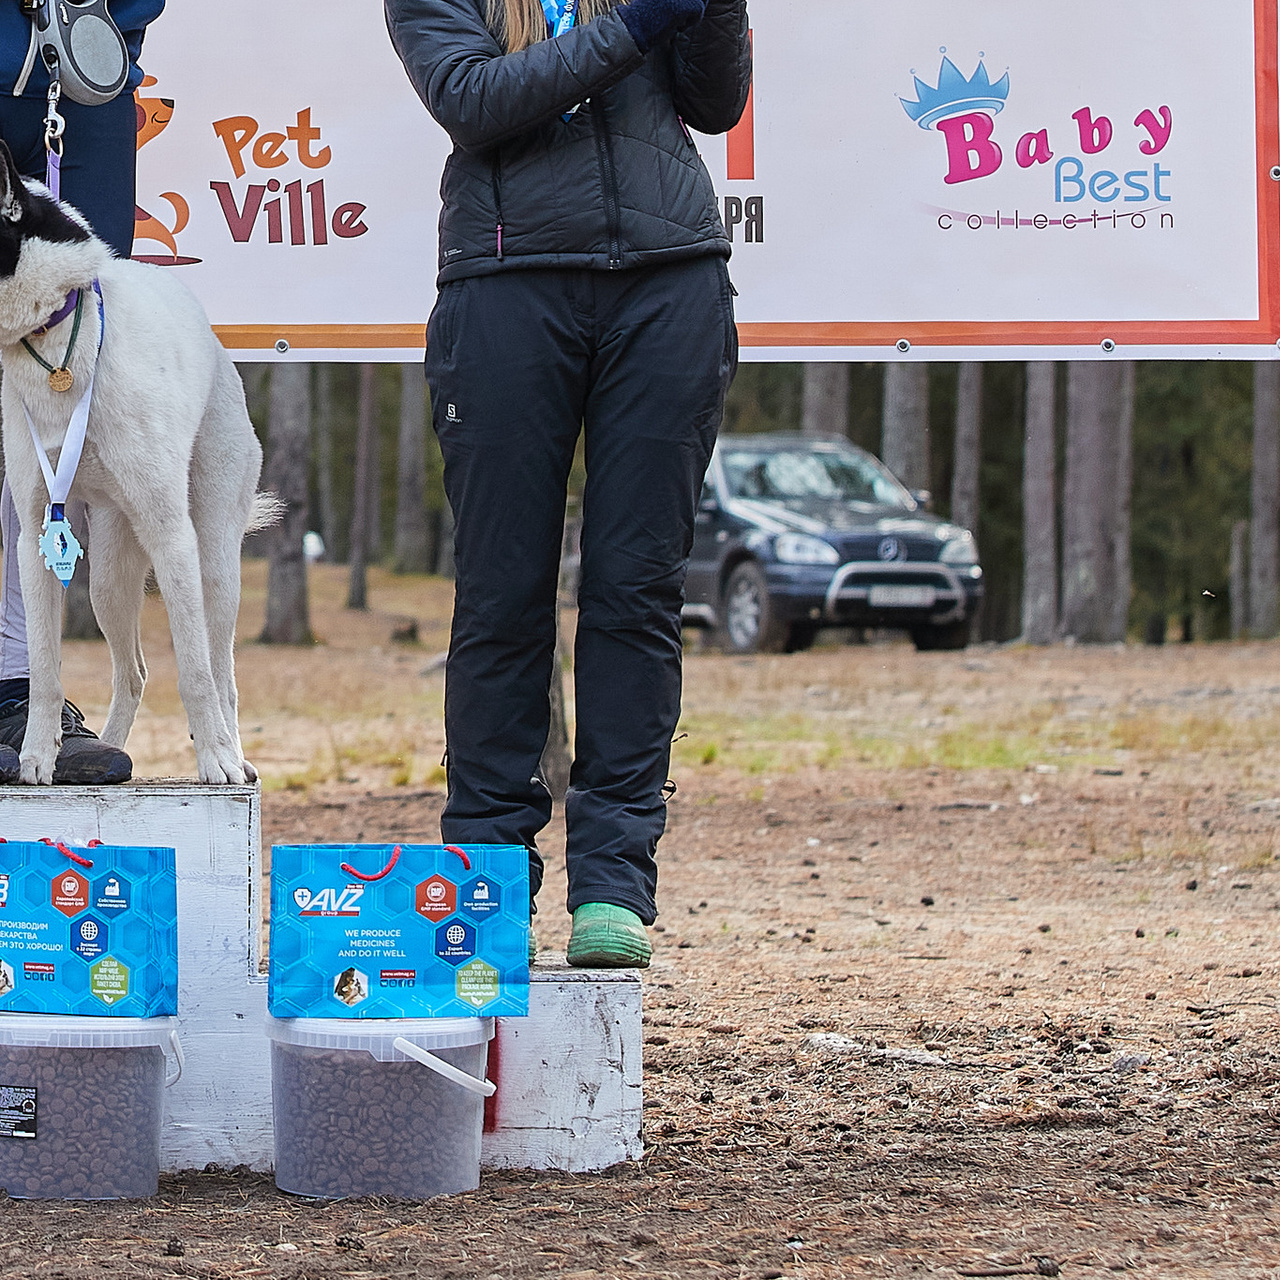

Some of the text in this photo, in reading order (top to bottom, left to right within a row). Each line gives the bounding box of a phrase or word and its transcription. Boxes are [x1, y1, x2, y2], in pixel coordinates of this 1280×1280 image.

[212, 107, 332, 179] Pet
[936, 105, 1172, 184] Baby
[1054, 157, 1172, 202] Best
[209, 177, 369, 247] Ville
[938, 209, 1174, 230] collection
[0, 920, 48, 931] ПРОИЗВОДИМ
[344, 929, 401, 937] WE PRODUCE
[9, 941, 25, 949] ЭТО
[26, 942, 64, 951] ХОРОШО!
[350, 939, 395, 947] MEDICINES
[338, 949, 406, 957] AND DO IT WELL
